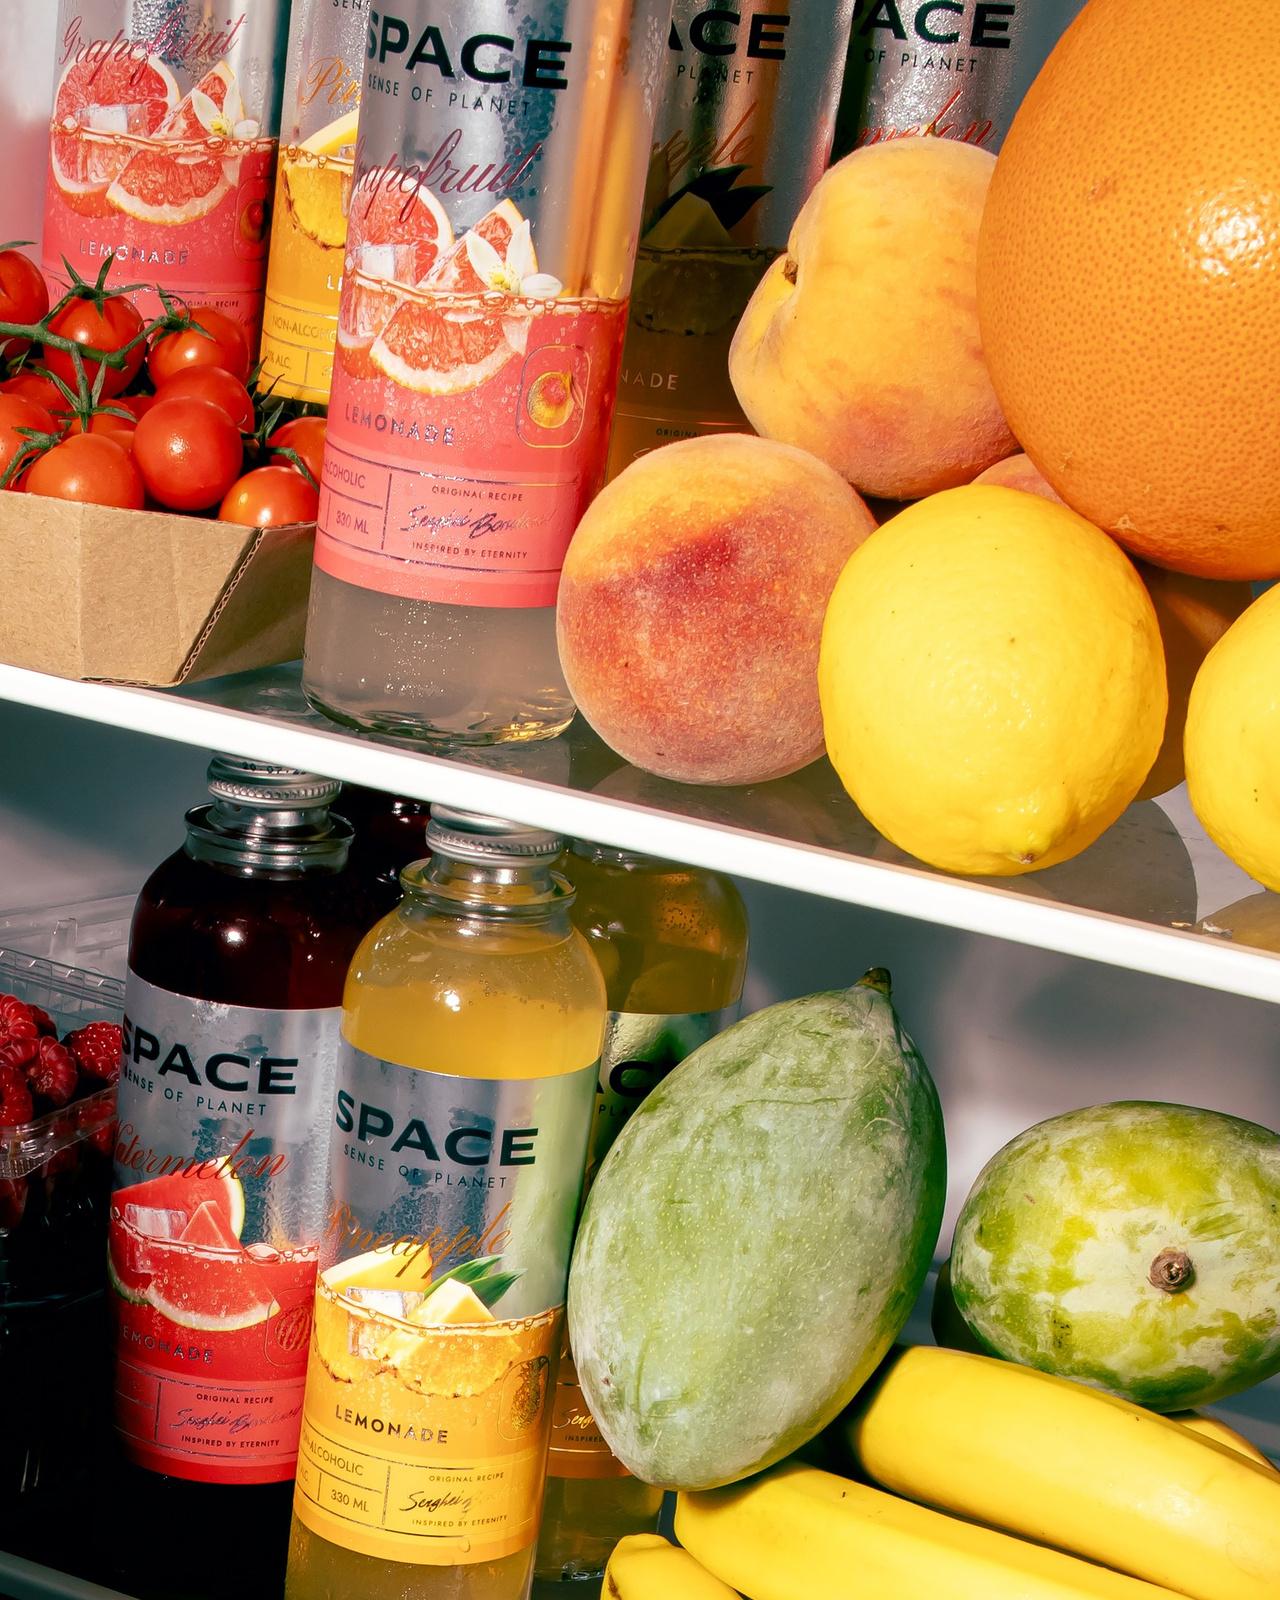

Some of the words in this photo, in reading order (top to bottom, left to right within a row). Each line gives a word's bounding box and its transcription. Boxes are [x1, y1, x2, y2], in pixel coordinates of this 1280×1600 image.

[58, 6, 247, 86] Grapefruit
[677, 65, 754, 84] PLANET
[901, 53, 977, 72] PLANET
[368, 73, 400, 97] SENSE
[411, 86, 433, 102] OF
[449, 92, 530, 116] PLANET
[79, 238, 189, 265] LEMONADE
[344, 402, 455, 446] LEMONADE
[656, 428, 698, 438] ORIGINA
[432, 485, 482, 499] ORIGINAL
[488, 492, 523, 501] RECIPE
[336, 510, 351, 528] 330
[354, 517, 369, 534] ML
[412, 541, 459, 555] INSPIRED
[481, 550, 527, 559] ETERNITY
[122, 1012, 299, 1094] SPACE
[164, 1087, 183, 1102] OF
[196, 1096, 266, 1115] PLANET
[336, 1089, 539, 1167] SPACE
[344, 1143, 385, 1171] SENSE
[398, 1165, 421, 1179] OF
[435, 1172, 506, 1189] PLANET
[324, 1199, 514, 1280] Pineapple
[123, 1325, 214, 1363] EMONADE
[196, 1393, 240, 1403] ORIGINAL
[244, 1396, 274, 1404] RECIPE
[335, 1404, 448, 1444] LEMONADE
[181, 1435, 222, 1447] INSPIRED
[240, 1440, 280, 1448] ETERNITY
[429, 1475, 472, 1483] ORIGINAL
[477, 1472, 505, 1481] RECIPE
[331, 1489, 350, 1505] 330
[353, 1498, 369, 1513] ML
[412, 1519, 454, 1527] INSPIRED
[472, 1515, 508, 1526] ETERNITY
